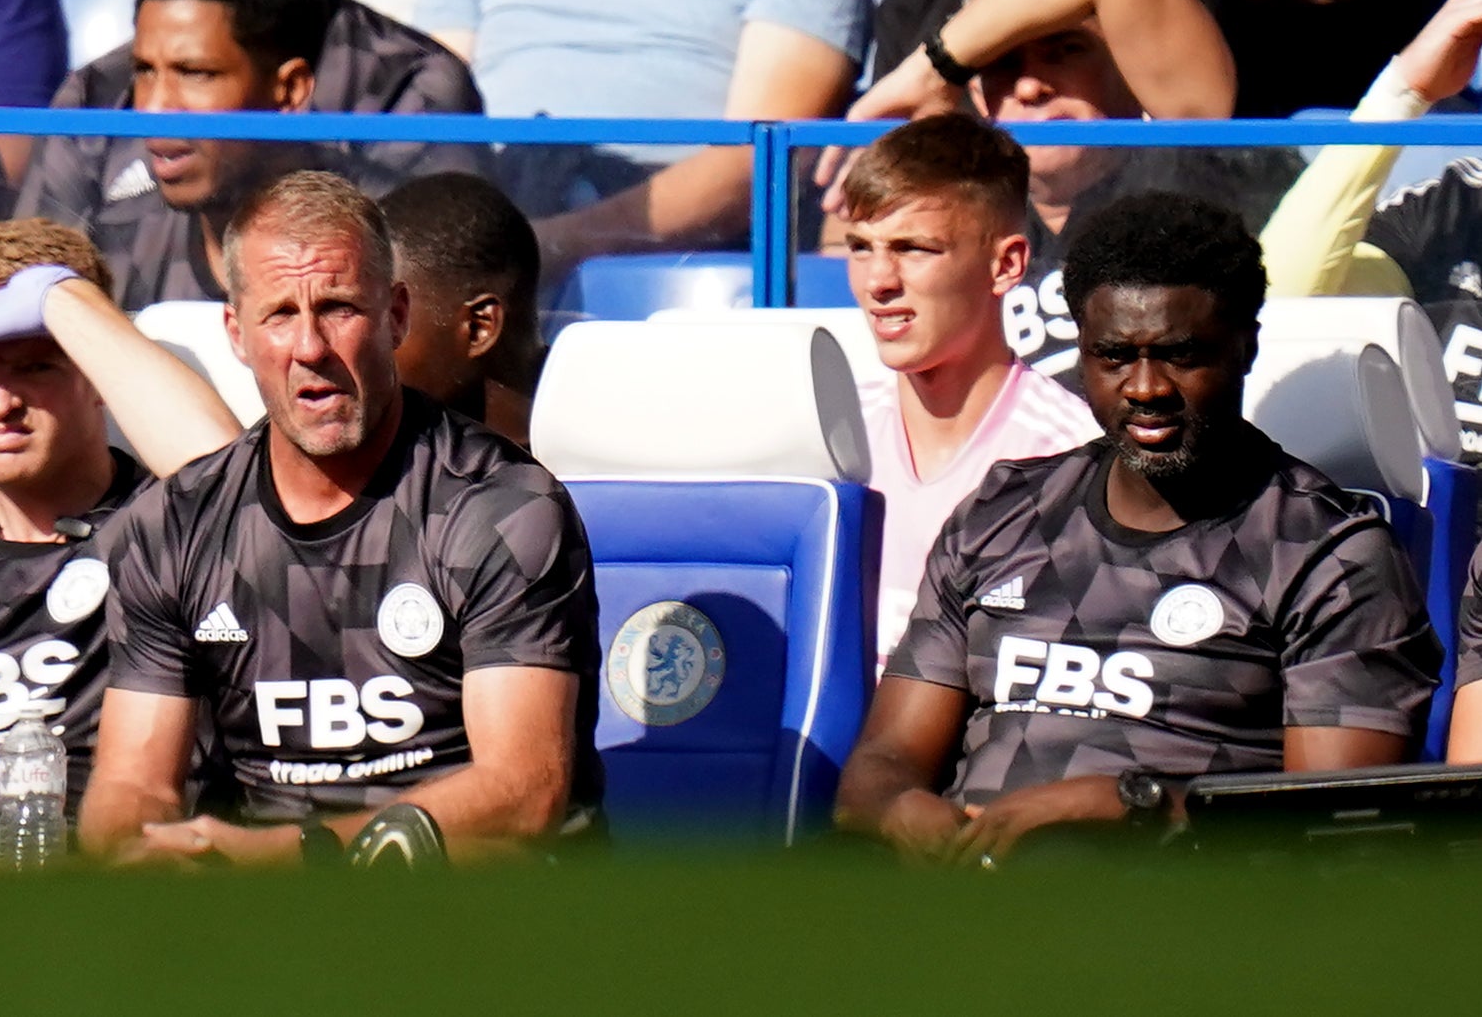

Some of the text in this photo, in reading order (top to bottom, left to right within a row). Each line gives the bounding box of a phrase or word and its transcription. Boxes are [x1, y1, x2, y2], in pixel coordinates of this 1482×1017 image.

[981, 595, 1025, 610] adidas
[195, 629, 249, 642] adidas
[994, 636, 1154, 719] FBS
[255, 675, 425, 748] FBS
[270, 760, 343, 784] trade
